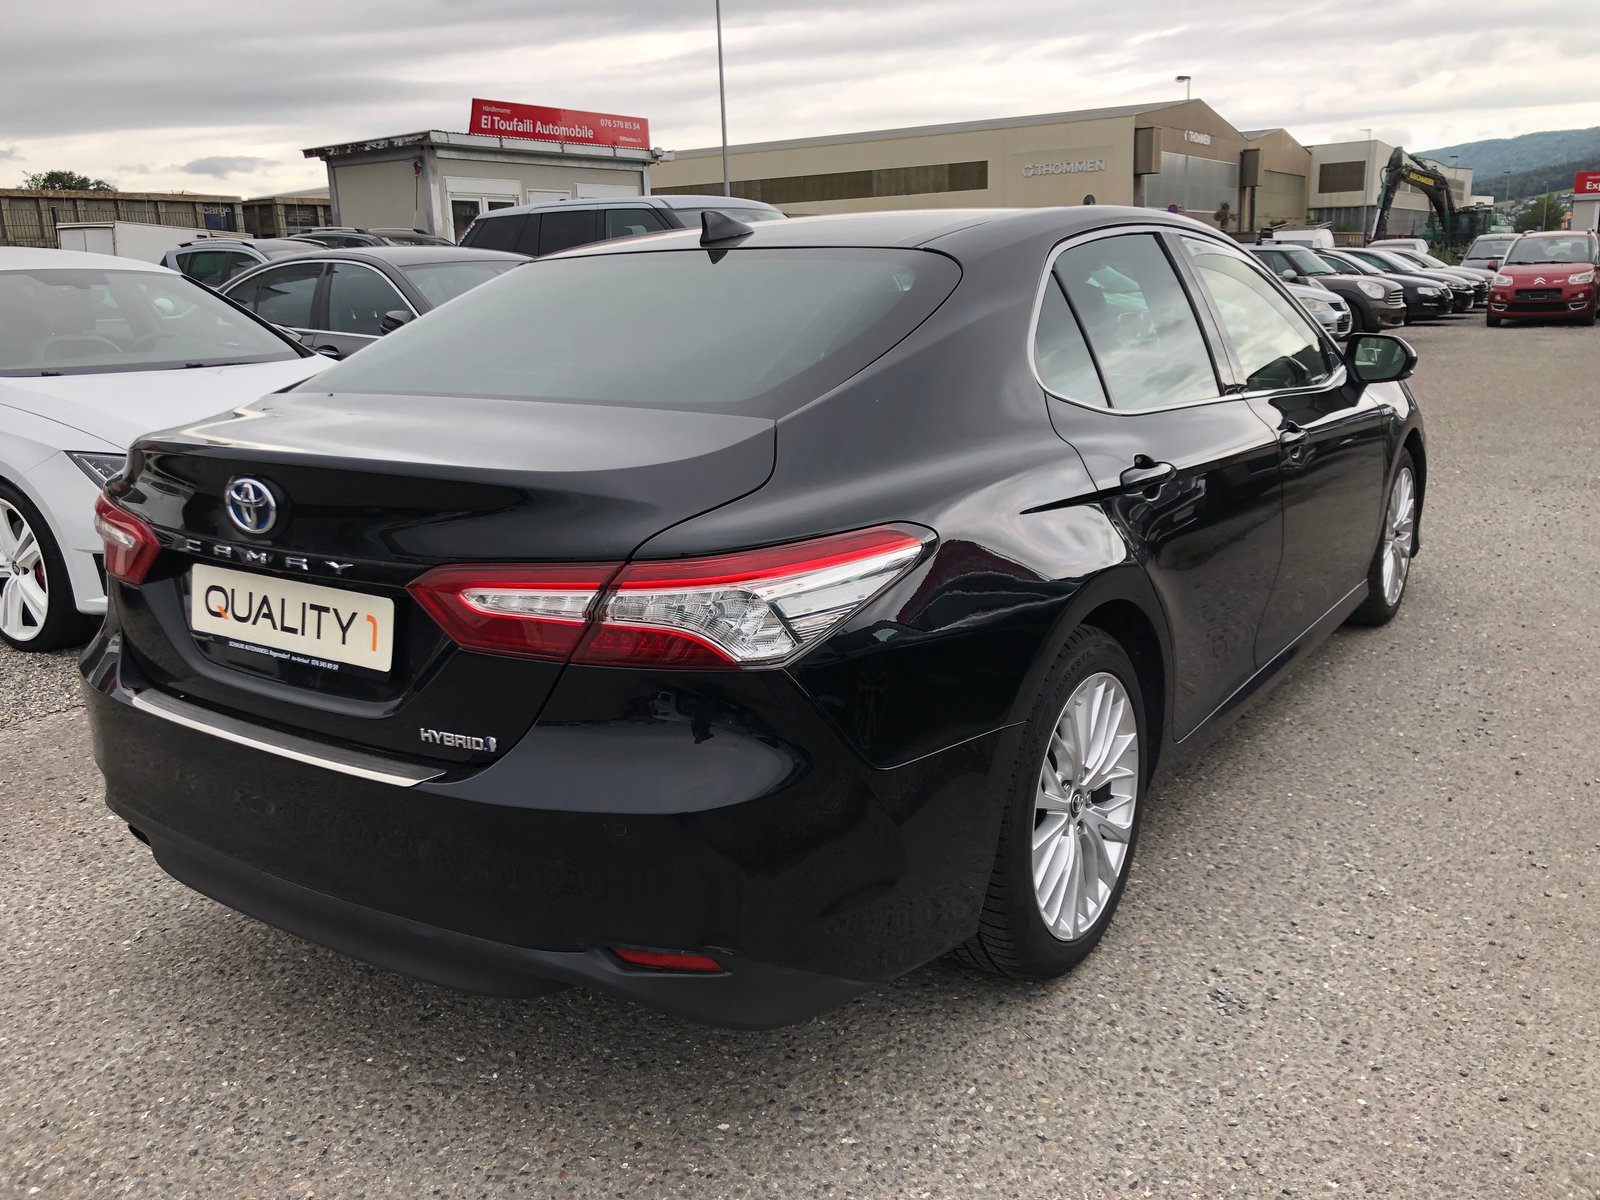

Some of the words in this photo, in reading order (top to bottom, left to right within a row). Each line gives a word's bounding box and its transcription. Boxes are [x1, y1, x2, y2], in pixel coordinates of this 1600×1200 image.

[481, 115, 492, 129] El
[493, 117, 533, 133] Toufaili
[535, 120, 594, 139] Automobile
[600, 118, 612, 128] 076
[612, 120, 624, 129] 578
[624, 121, 632, 130] 85
[633, 122, 640, 130] 54
[1034, 159, 1105, 176] THOMMEN
[1586, 181, 1600, 191] Ex
[186, 538, 354, 575] CAMRY
[205, 584, 358, 645] QUALITY
[420, 728, 484, 751] HYBRID
